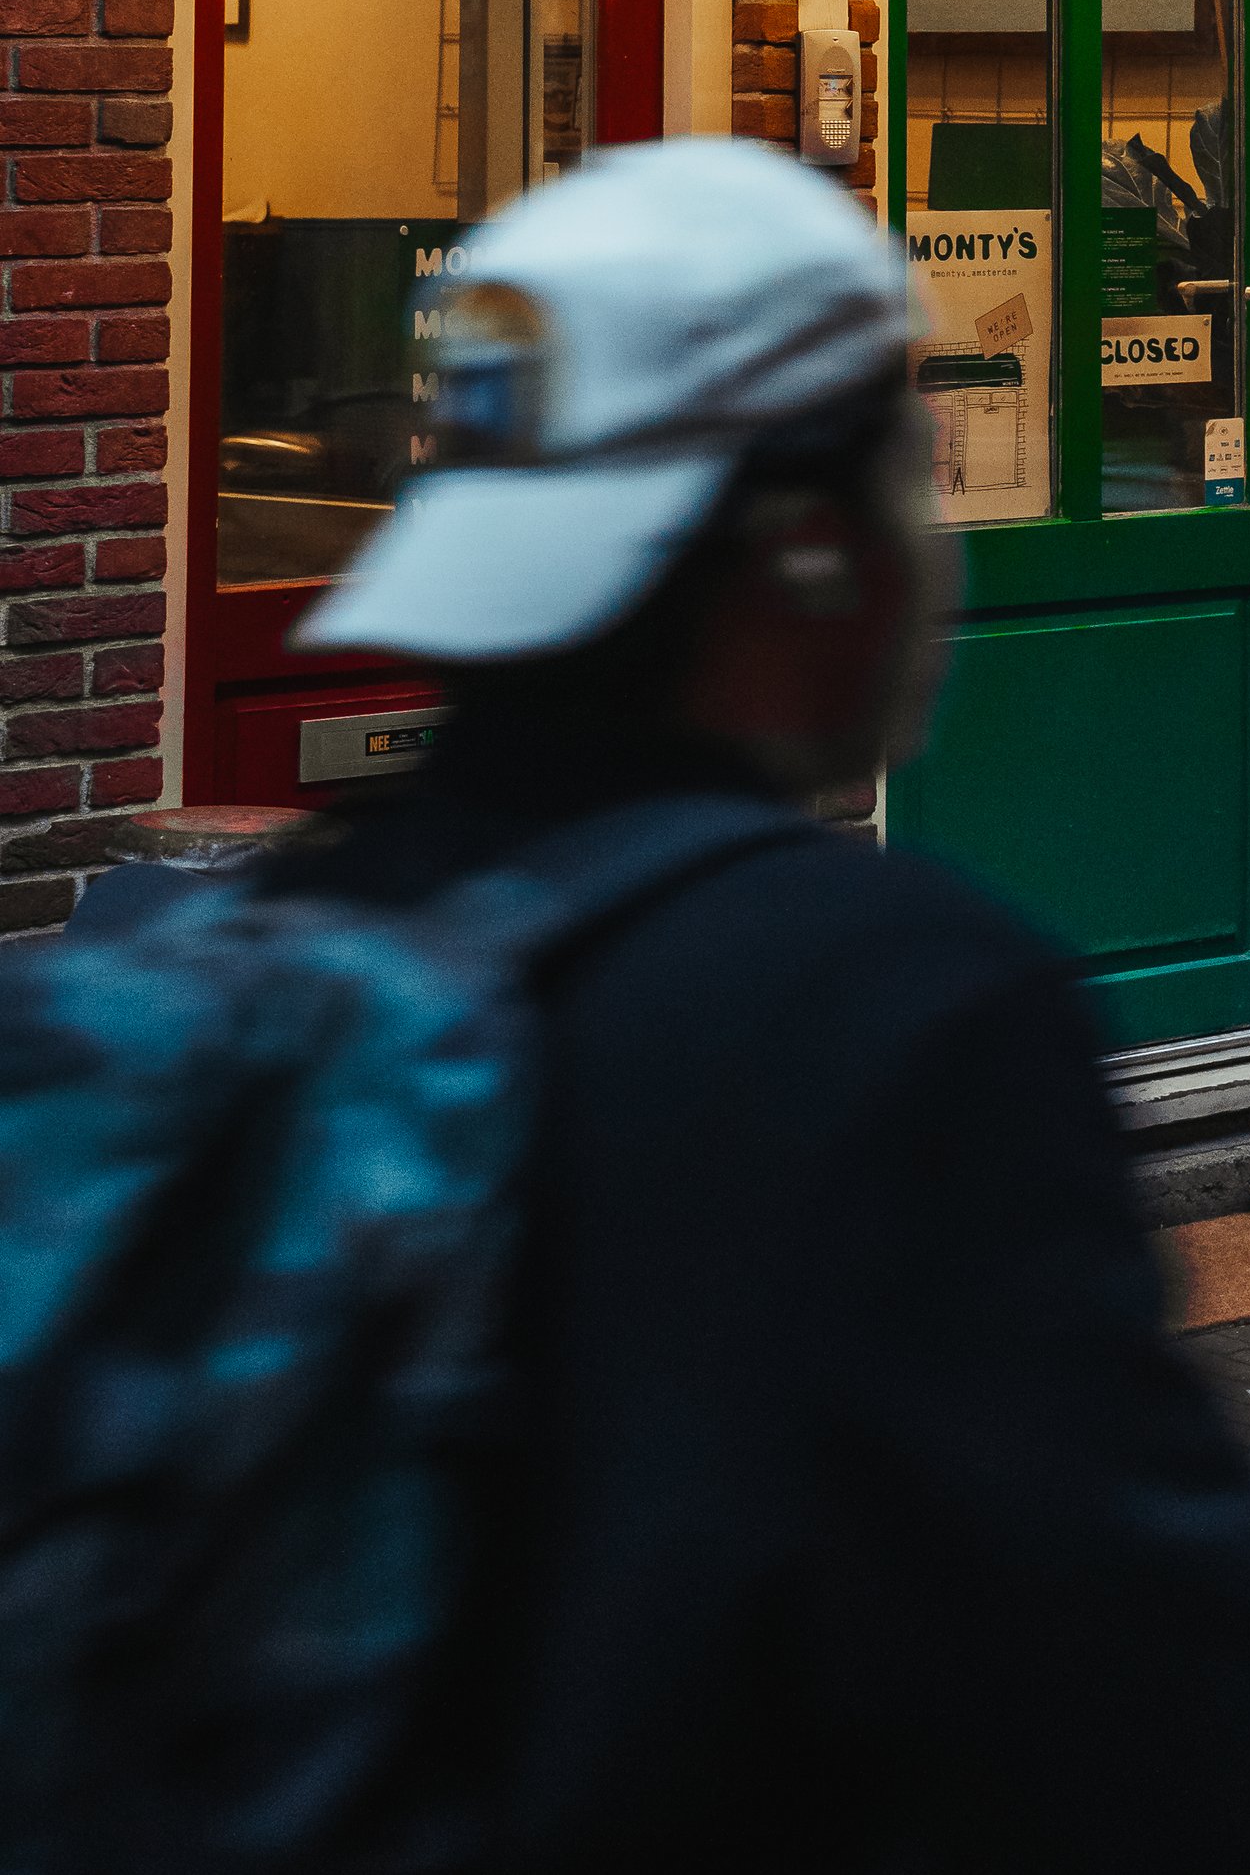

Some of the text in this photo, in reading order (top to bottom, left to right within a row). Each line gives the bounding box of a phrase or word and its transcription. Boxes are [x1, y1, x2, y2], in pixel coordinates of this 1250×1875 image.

[909, 226, 1038, 262] MONTY'S
[993, 323, 1018, 342] OPEN
[1101, 337, 1200, 365] CLOSED
[369, 734, 390, 753] NEE
